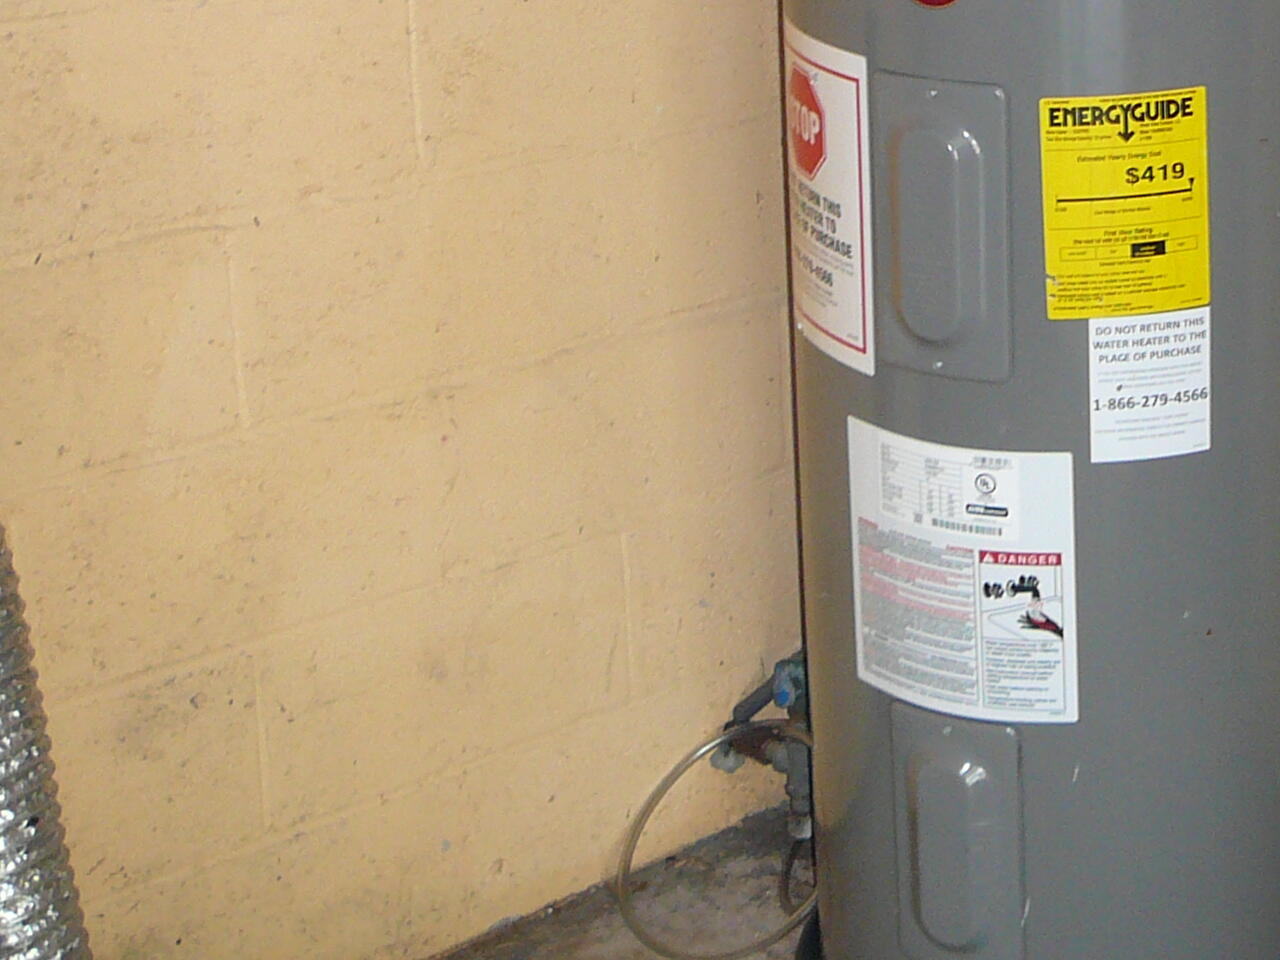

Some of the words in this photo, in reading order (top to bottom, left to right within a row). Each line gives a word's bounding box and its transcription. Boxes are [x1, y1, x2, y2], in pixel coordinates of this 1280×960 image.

[789, 95, 820, 145] TOP
[1125, 162, 1185, 185] $419
[1095, 326, 1112, 336] DO
[1114, 324, 1137, 335] NOT
[1139, 321, 1181, 333] RETURN
[1183, 316, 1205, 327] THIS
[1092, 338, 1129, 350] WATER
[1131, 336, 1170, 347] HEATER
[1173, 334, 1187, 344] TO
[1189, 330, 1207, 341] THE
[1098, 351, 1130, 364] PLACE
[1133, 350, 1147, 361] OF
[1150, 344, 1202, 360] PURCHASE
[1093, 387, 1208, 411] 1-866-279-4566
[997, 552, 1058, 564] DANGER
